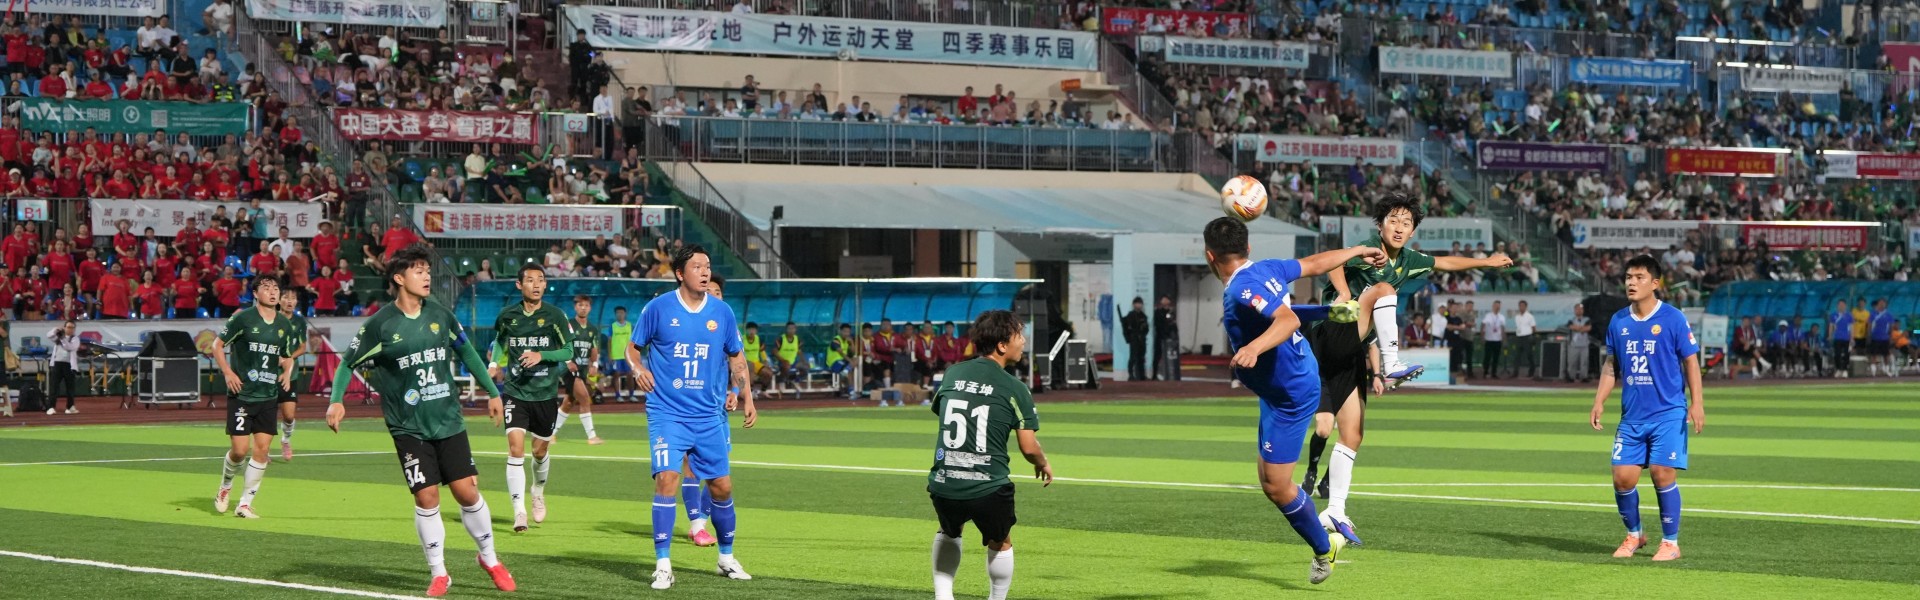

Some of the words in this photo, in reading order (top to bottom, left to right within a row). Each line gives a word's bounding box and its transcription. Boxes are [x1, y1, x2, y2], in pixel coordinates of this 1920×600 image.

[773, 22, 914, 51] 户外运动天堂
[943, 31, 1075, 60] 四季赛事乐园
[340, 112, 421, 136] 中国大益
[567, 119, 584, 131] C2
[24, 207, 42, 219] B1
[646, 213, 662, 225] C1
[248, 341, 280, 355] 西双版
[509, 336, 549, 347] 西双版纳
[1626, 339, 1656, 355] 红河
[396, 346, 446, 370] 西双版纳
[673, 342, 710, 360] 红河
[261, 355, 269, 369] 2
[683, 360, 699, 379] 11
[1631, 355, 1649, 373] 32
[416, 366, 437, 387] 34
[953, 380, 994, 396] 邓孟坤
[235, 416, 245, 431] 2
[505, 408, 512, 424] 5
[943, 398, 990, 453] 51
[655, 449, 669, 467] 11
[1612, 442, 1623, 460] 2
[405, 464, 426, 488] 34
